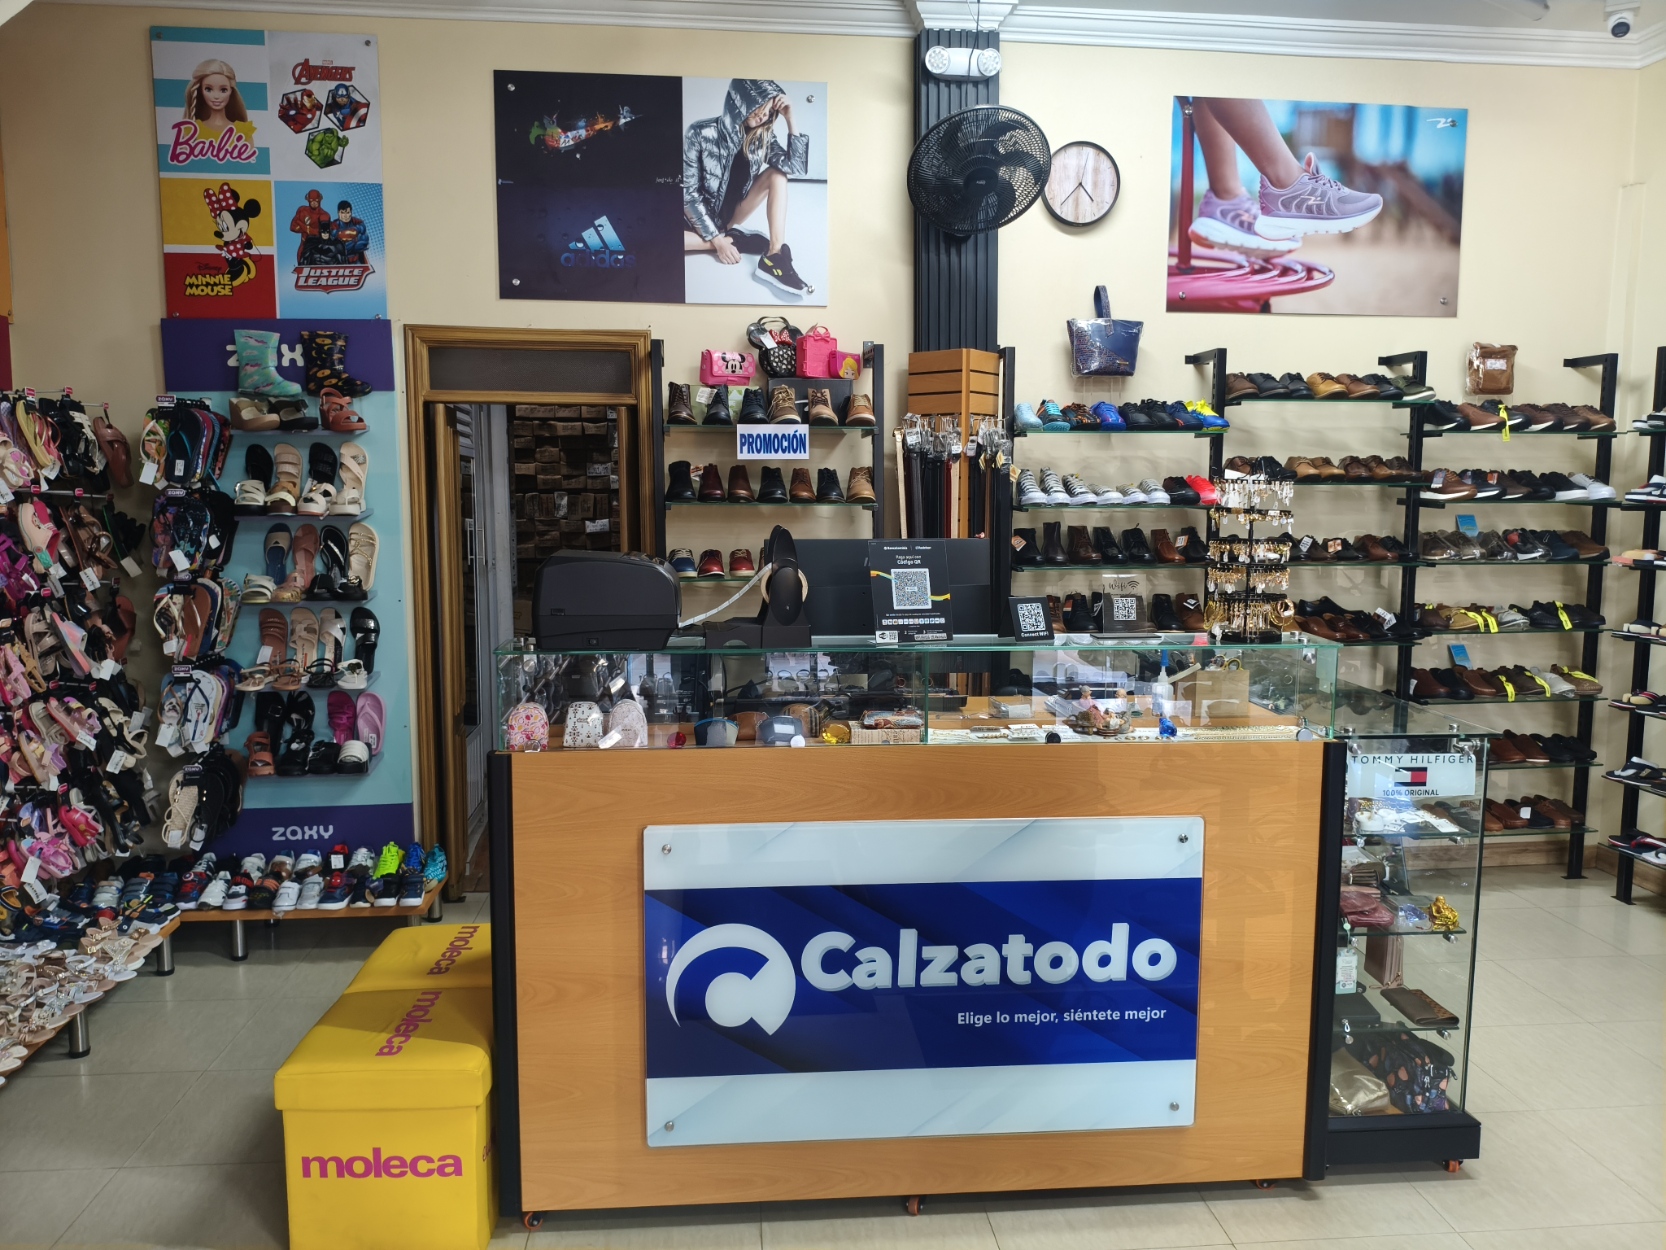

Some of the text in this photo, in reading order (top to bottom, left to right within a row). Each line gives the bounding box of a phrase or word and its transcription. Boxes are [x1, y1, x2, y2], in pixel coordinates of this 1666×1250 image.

[292, 57, 356, 86] AVENGERS
[169, 120, 257, 165] Barbie
[560, 249, 636, 269] adidas
[185, 274, 232, 286] MINNIE
[298, 276, 360, 286] LEAGUE
[299, 267, 364, 277] JUSTICE
[185, 285, 233, 297] MOUSE
[739, 429, 807, 455] PROMOCIÓN
[1352, 754, 1475, 765] TOMMY HILFIGER
[1383, 788, 1440, 797] 100% ORIGINAL
[426, 925, 481, 976] moleca
[801, 922, 1178, 992] Calzatodo
[375, 991, 443, 1057] moleca
[957, 1006, 1167, 1027] Elige lo mejor, siéntete mejor
[301, 1147, 463, 1179] moleca
